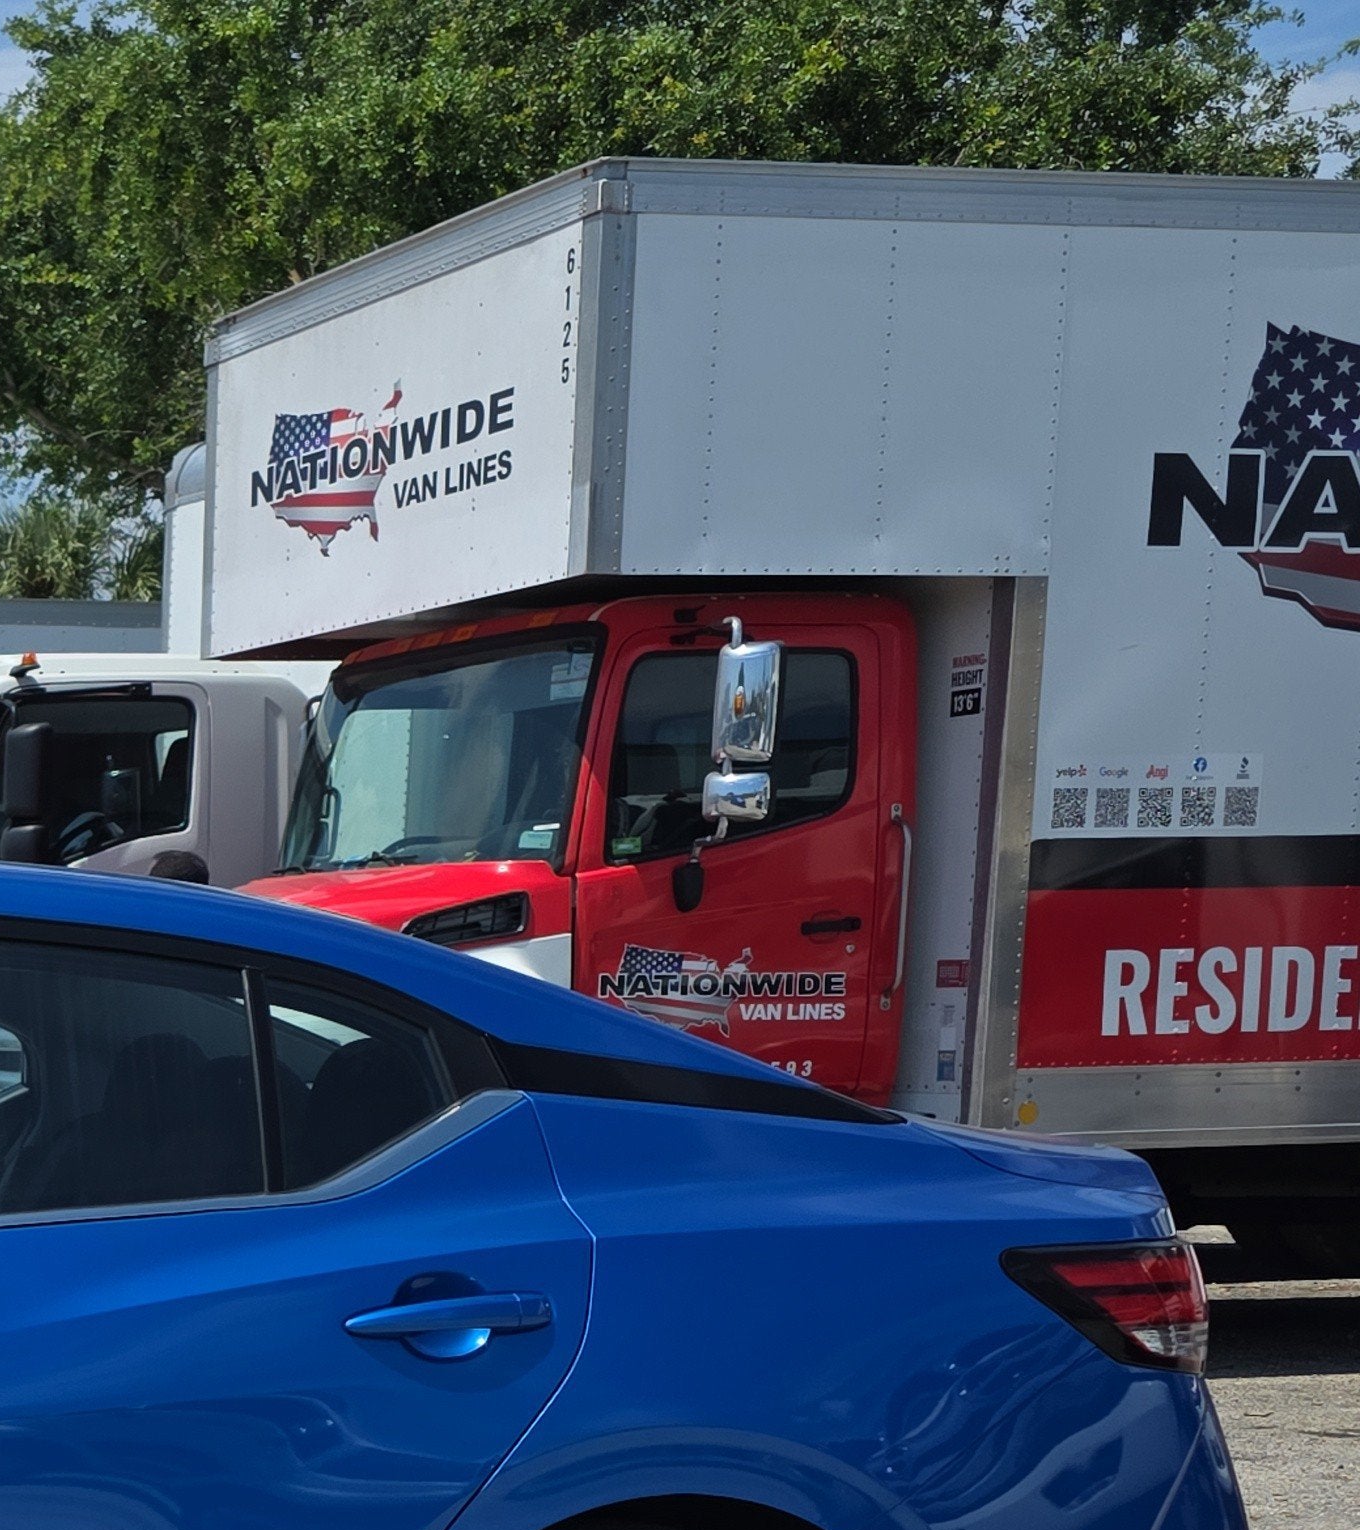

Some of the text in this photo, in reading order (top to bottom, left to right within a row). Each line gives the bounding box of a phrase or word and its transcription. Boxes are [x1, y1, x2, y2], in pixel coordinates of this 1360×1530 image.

[561, 248, 576, 384] 6125
[250, 386, 515, 508] NATIONWIDE
[393, 450, 512, 509] VAN LINES
[951, 668, 984, 688] HEIGHT
[1056, 766, 1079, 778] yelp
[1099, 766, 1128, 779] Google
[1146, 765, 1169, 780] Angi
[599, 973, 846, 997] NATIONWIDE
[740, 1002, 846, 1020] VAN LINES
